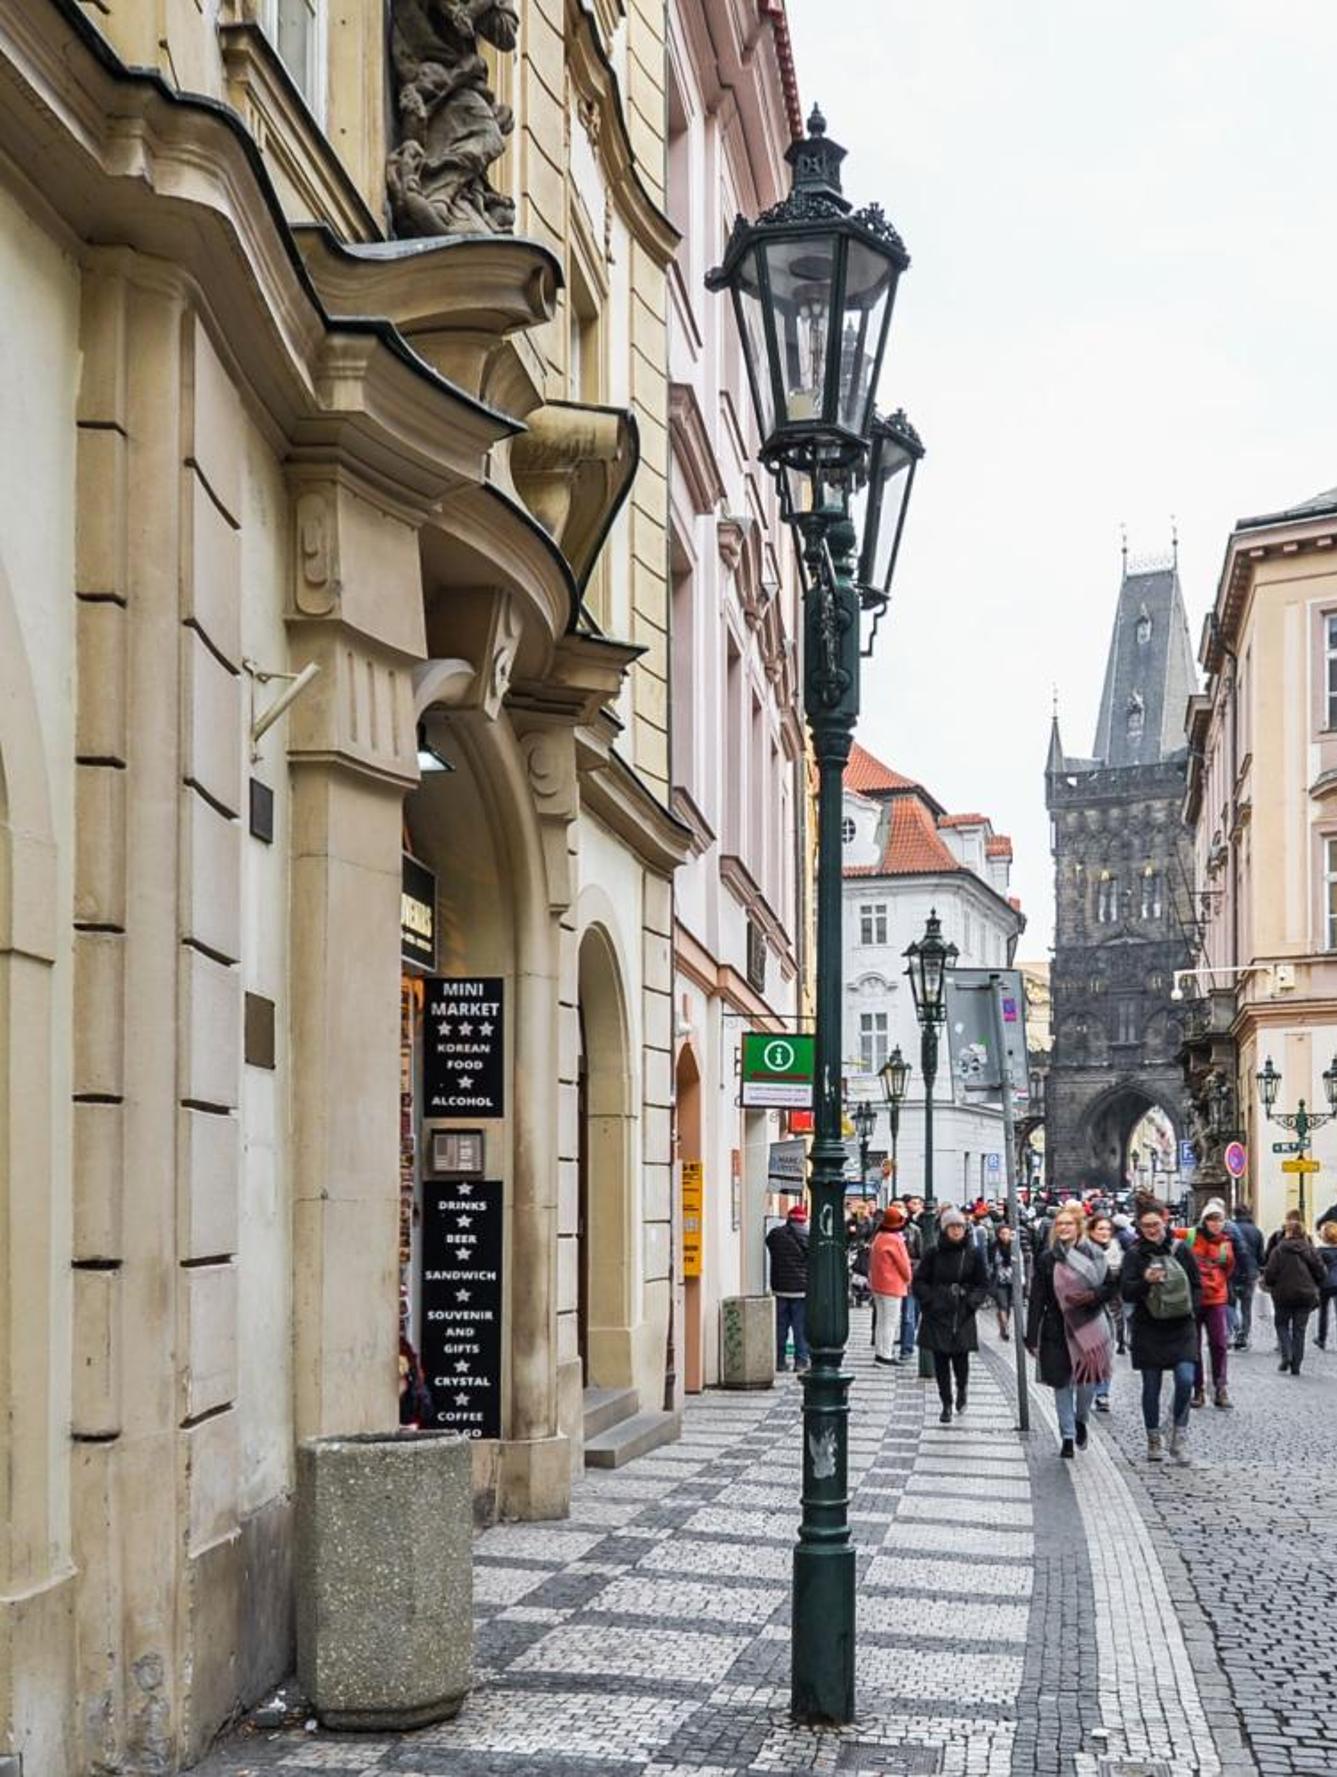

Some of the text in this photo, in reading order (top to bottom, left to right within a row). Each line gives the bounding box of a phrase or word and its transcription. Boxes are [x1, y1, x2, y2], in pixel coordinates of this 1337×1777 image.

[443, 983, 484, 996] MINI
[431, 1003, 500, 1016] MARKET
[437, 1043, 491, 1053] KOREAN
[447, 1060, 483, 1070] FOOD
[431, 1096, 494, 1107] ALCOHOL
[438, 1201, 487, 1211] DRINKS
[446, 1234, 477, 1244] BEER
[425, 1270, 497, 1281] SANDWICH
[427, 1310, 493, 1320] SOUVENIR
[445, 1327, 475, 1337] AND
[443, 1343, 480, 1354] GIFTS
[434, 1376, 491, 1387] CRYSTAL
[437, 1411, 483, 1421] COFFEE
